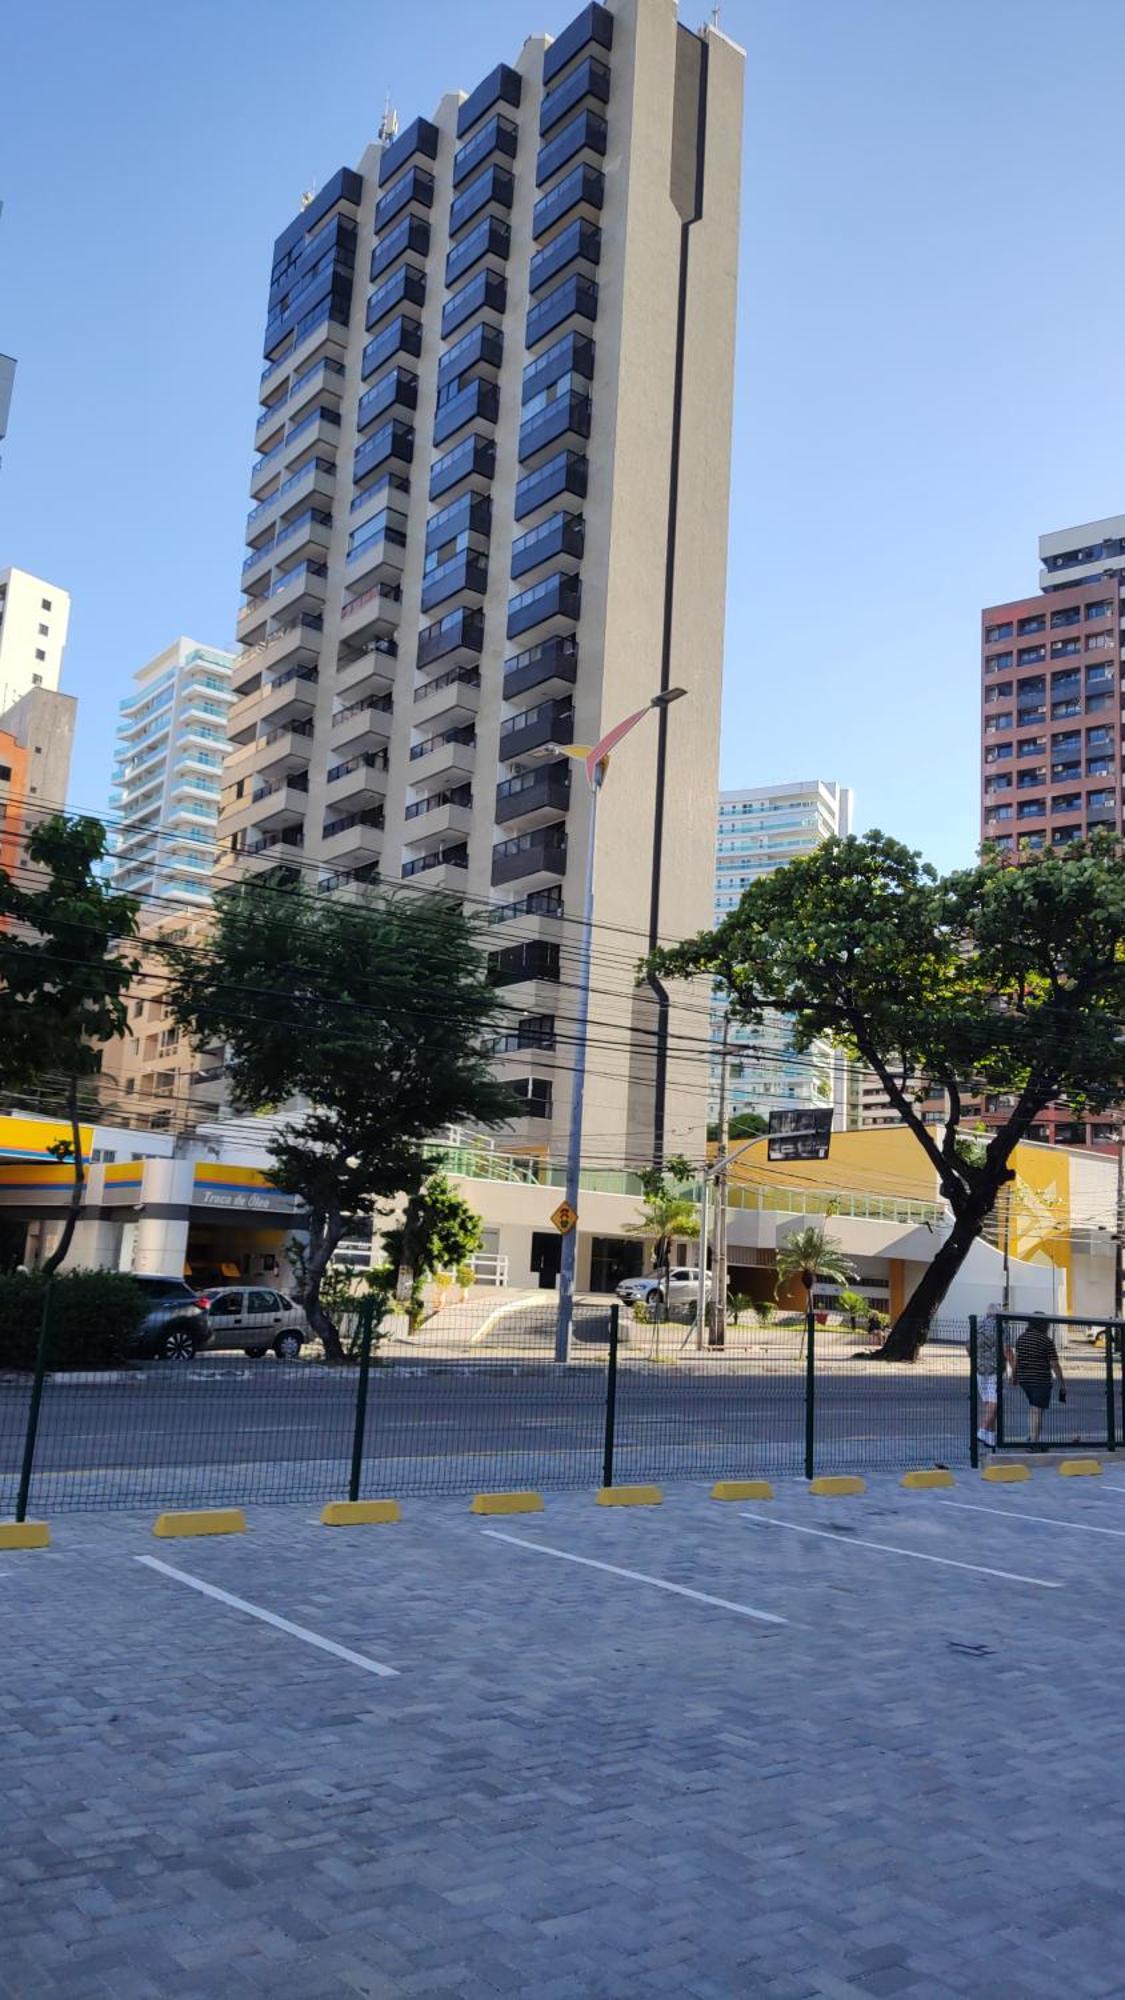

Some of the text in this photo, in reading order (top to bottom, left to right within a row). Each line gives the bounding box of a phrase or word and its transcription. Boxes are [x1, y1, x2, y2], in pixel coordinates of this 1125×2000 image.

[203, 1191, 270, 1208] Troca de Óleo
